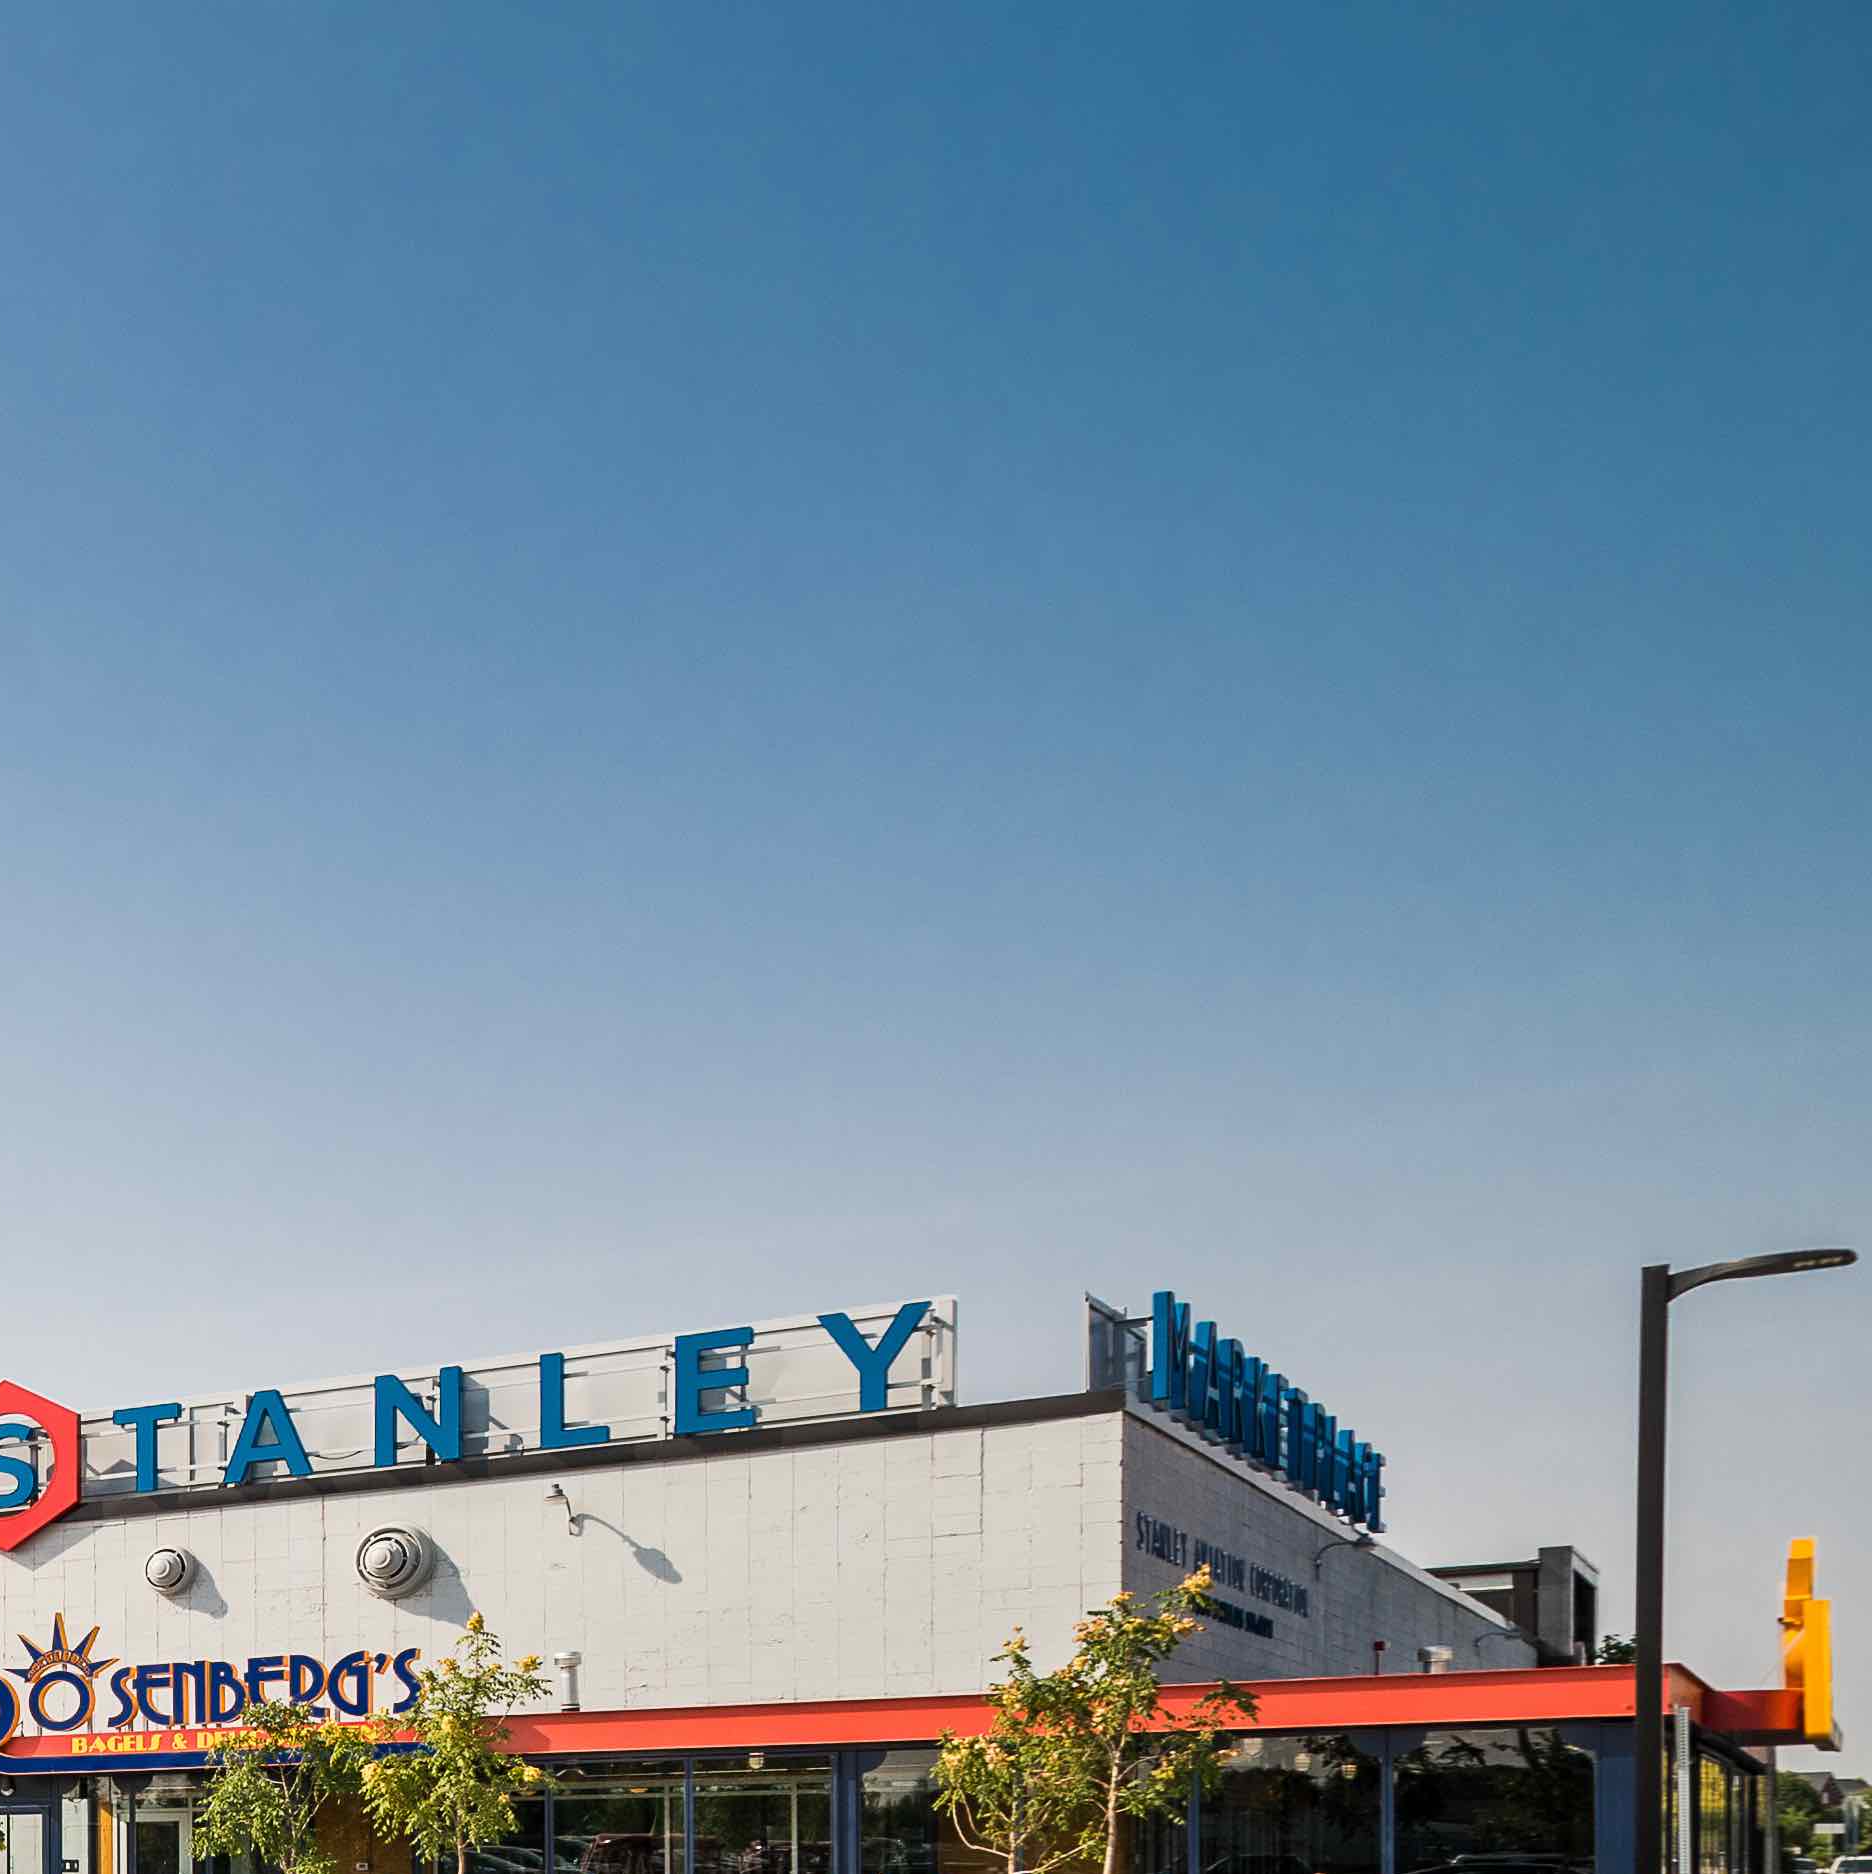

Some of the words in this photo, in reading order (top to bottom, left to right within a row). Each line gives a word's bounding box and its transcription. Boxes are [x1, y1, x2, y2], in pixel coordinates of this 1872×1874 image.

[1136, 1511, 1187, 1568] STANLEY
[70, 1734, 162, 1755] BAGELS
[171, 1732, 188, 1750] &
